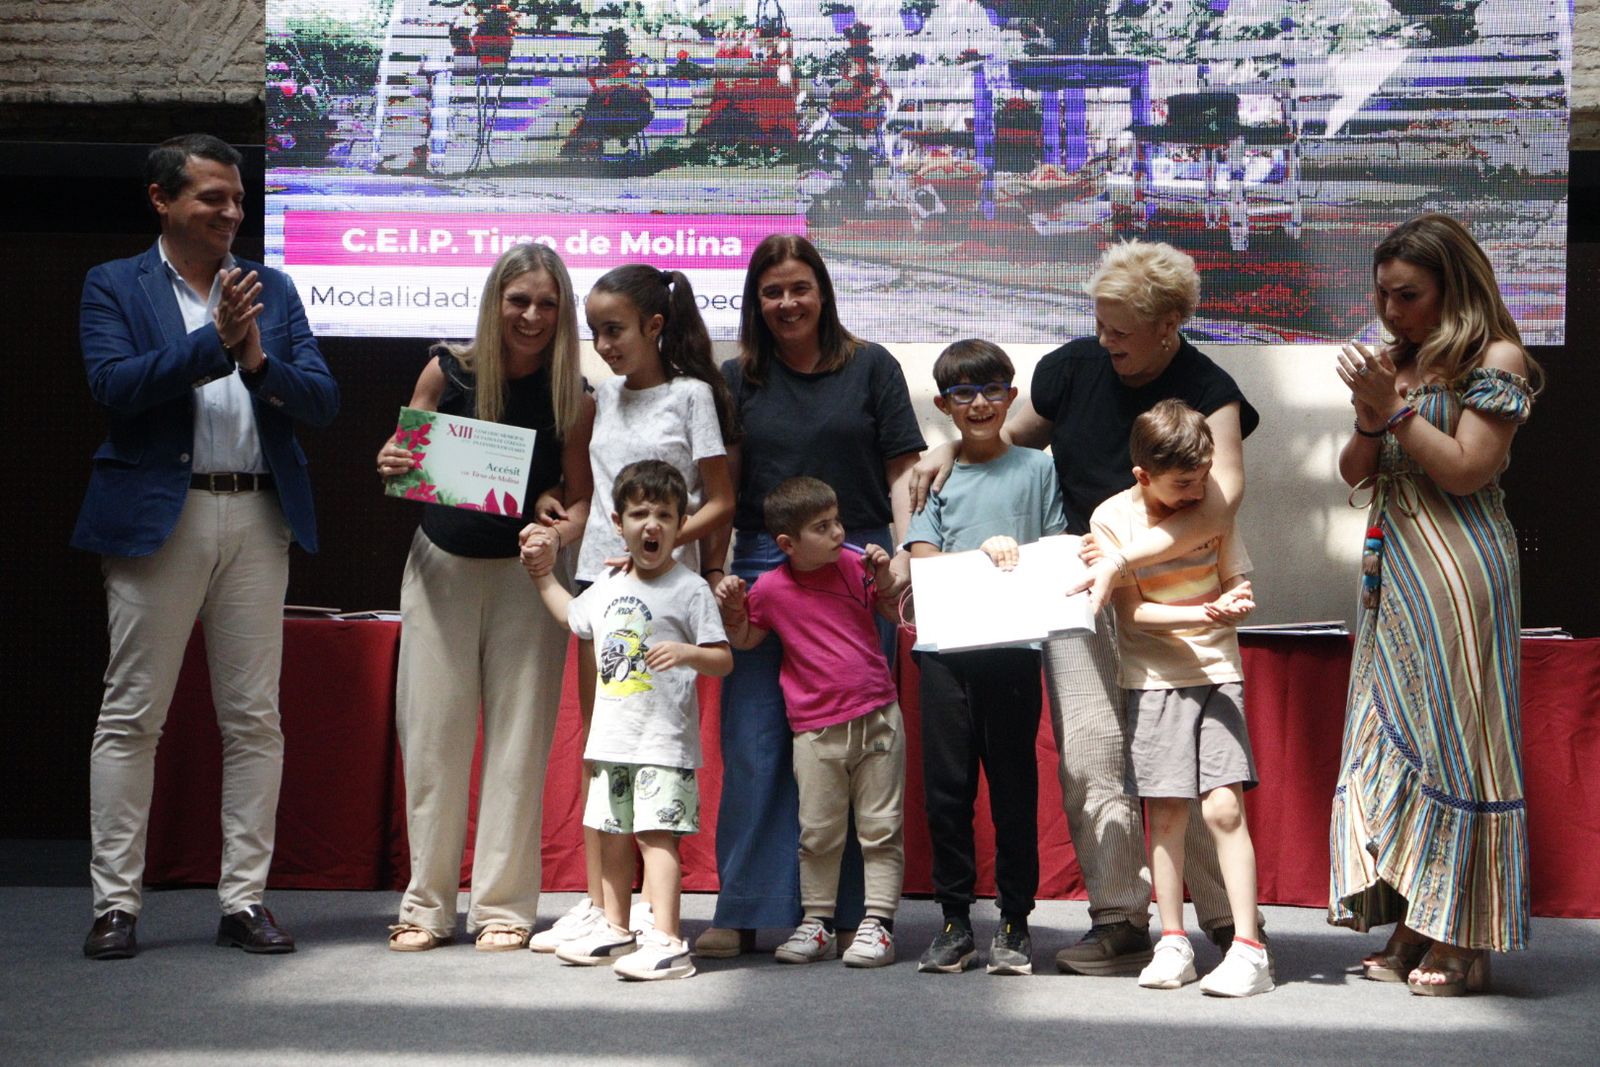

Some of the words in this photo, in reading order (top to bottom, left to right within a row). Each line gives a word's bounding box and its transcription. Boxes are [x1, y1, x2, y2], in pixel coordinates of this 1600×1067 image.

[341, 227, 459, 255] C.E.I.P.
[565, 228, 612, 256] de
[620, 228, 743, 257] Molina
[311, 285, 478, 308] Modalidad:
[447, 423, 473, 439] XIII
